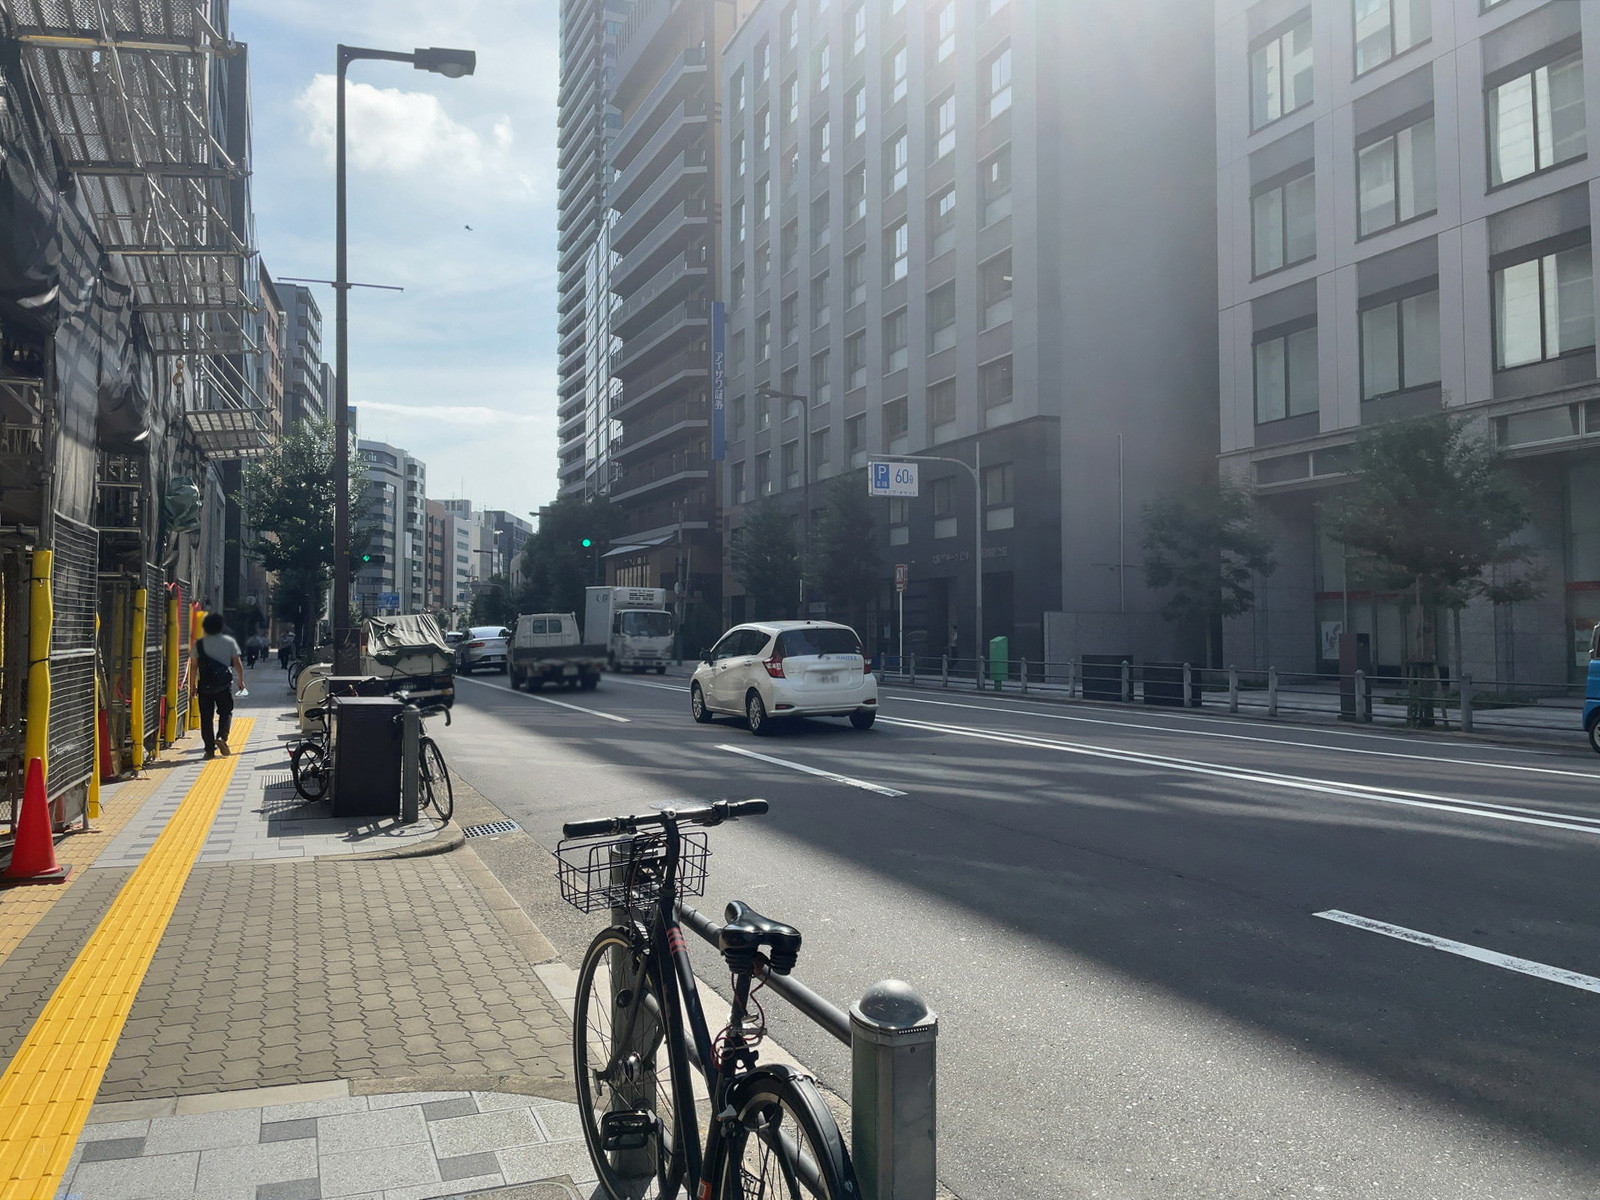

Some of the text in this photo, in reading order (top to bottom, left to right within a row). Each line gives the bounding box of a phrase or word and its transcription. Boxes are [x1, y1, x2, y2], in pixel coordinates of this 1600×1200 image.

[714, 351, 724, 410] アイザワ証券
[878, 465, 887, 479] P
